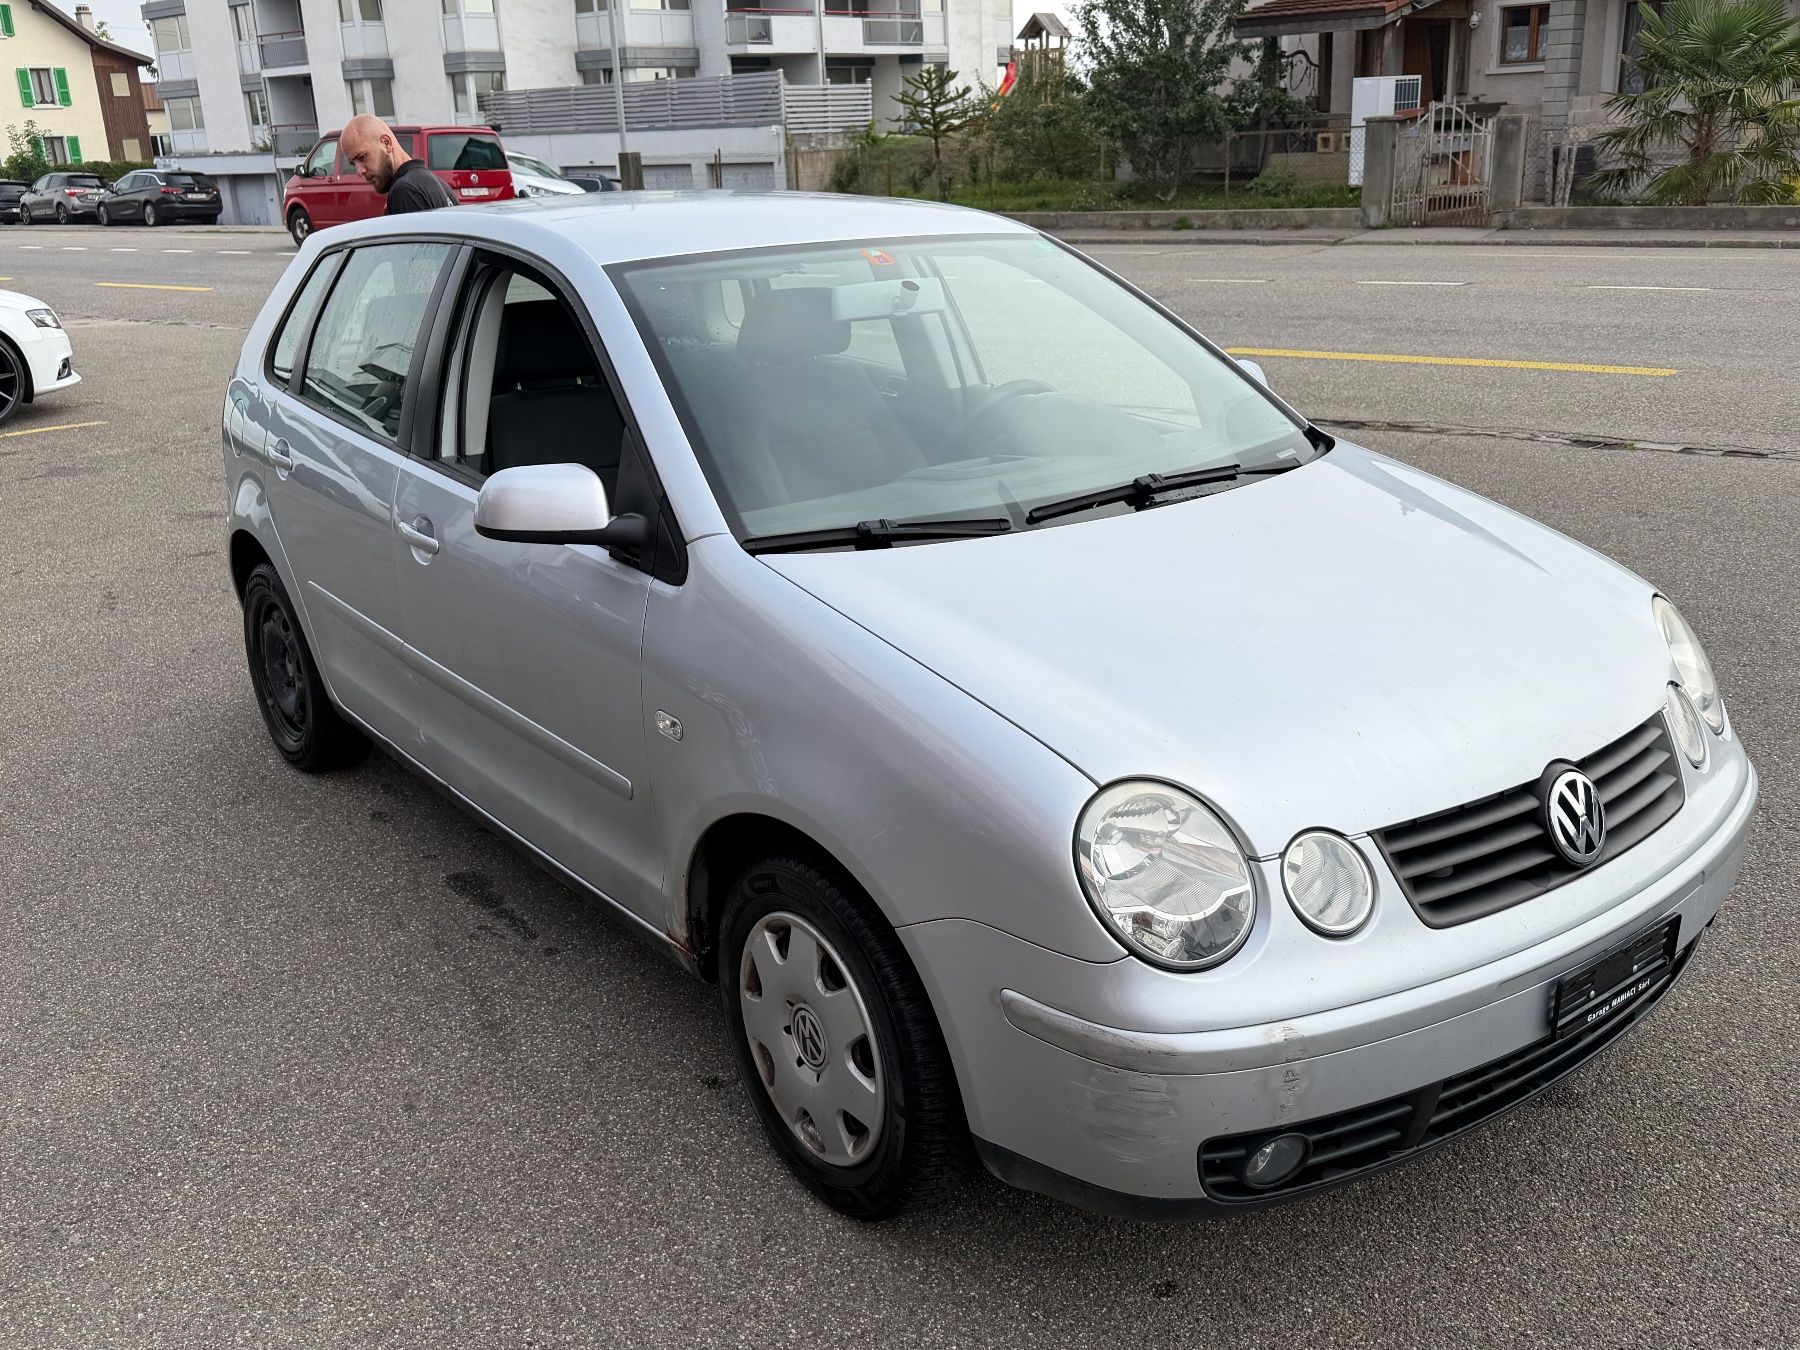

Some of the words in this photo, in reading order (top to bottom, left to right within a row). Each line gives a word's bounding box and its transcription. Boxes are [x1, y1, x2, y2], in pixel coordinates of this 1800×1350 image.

[1549, 771, 1605, 863] VW
[1587, 1004, 1610, 1022] Garage
[1611, 987, 1636, 1007] MANIACI
[795, 1010, 825, 1066] VW
